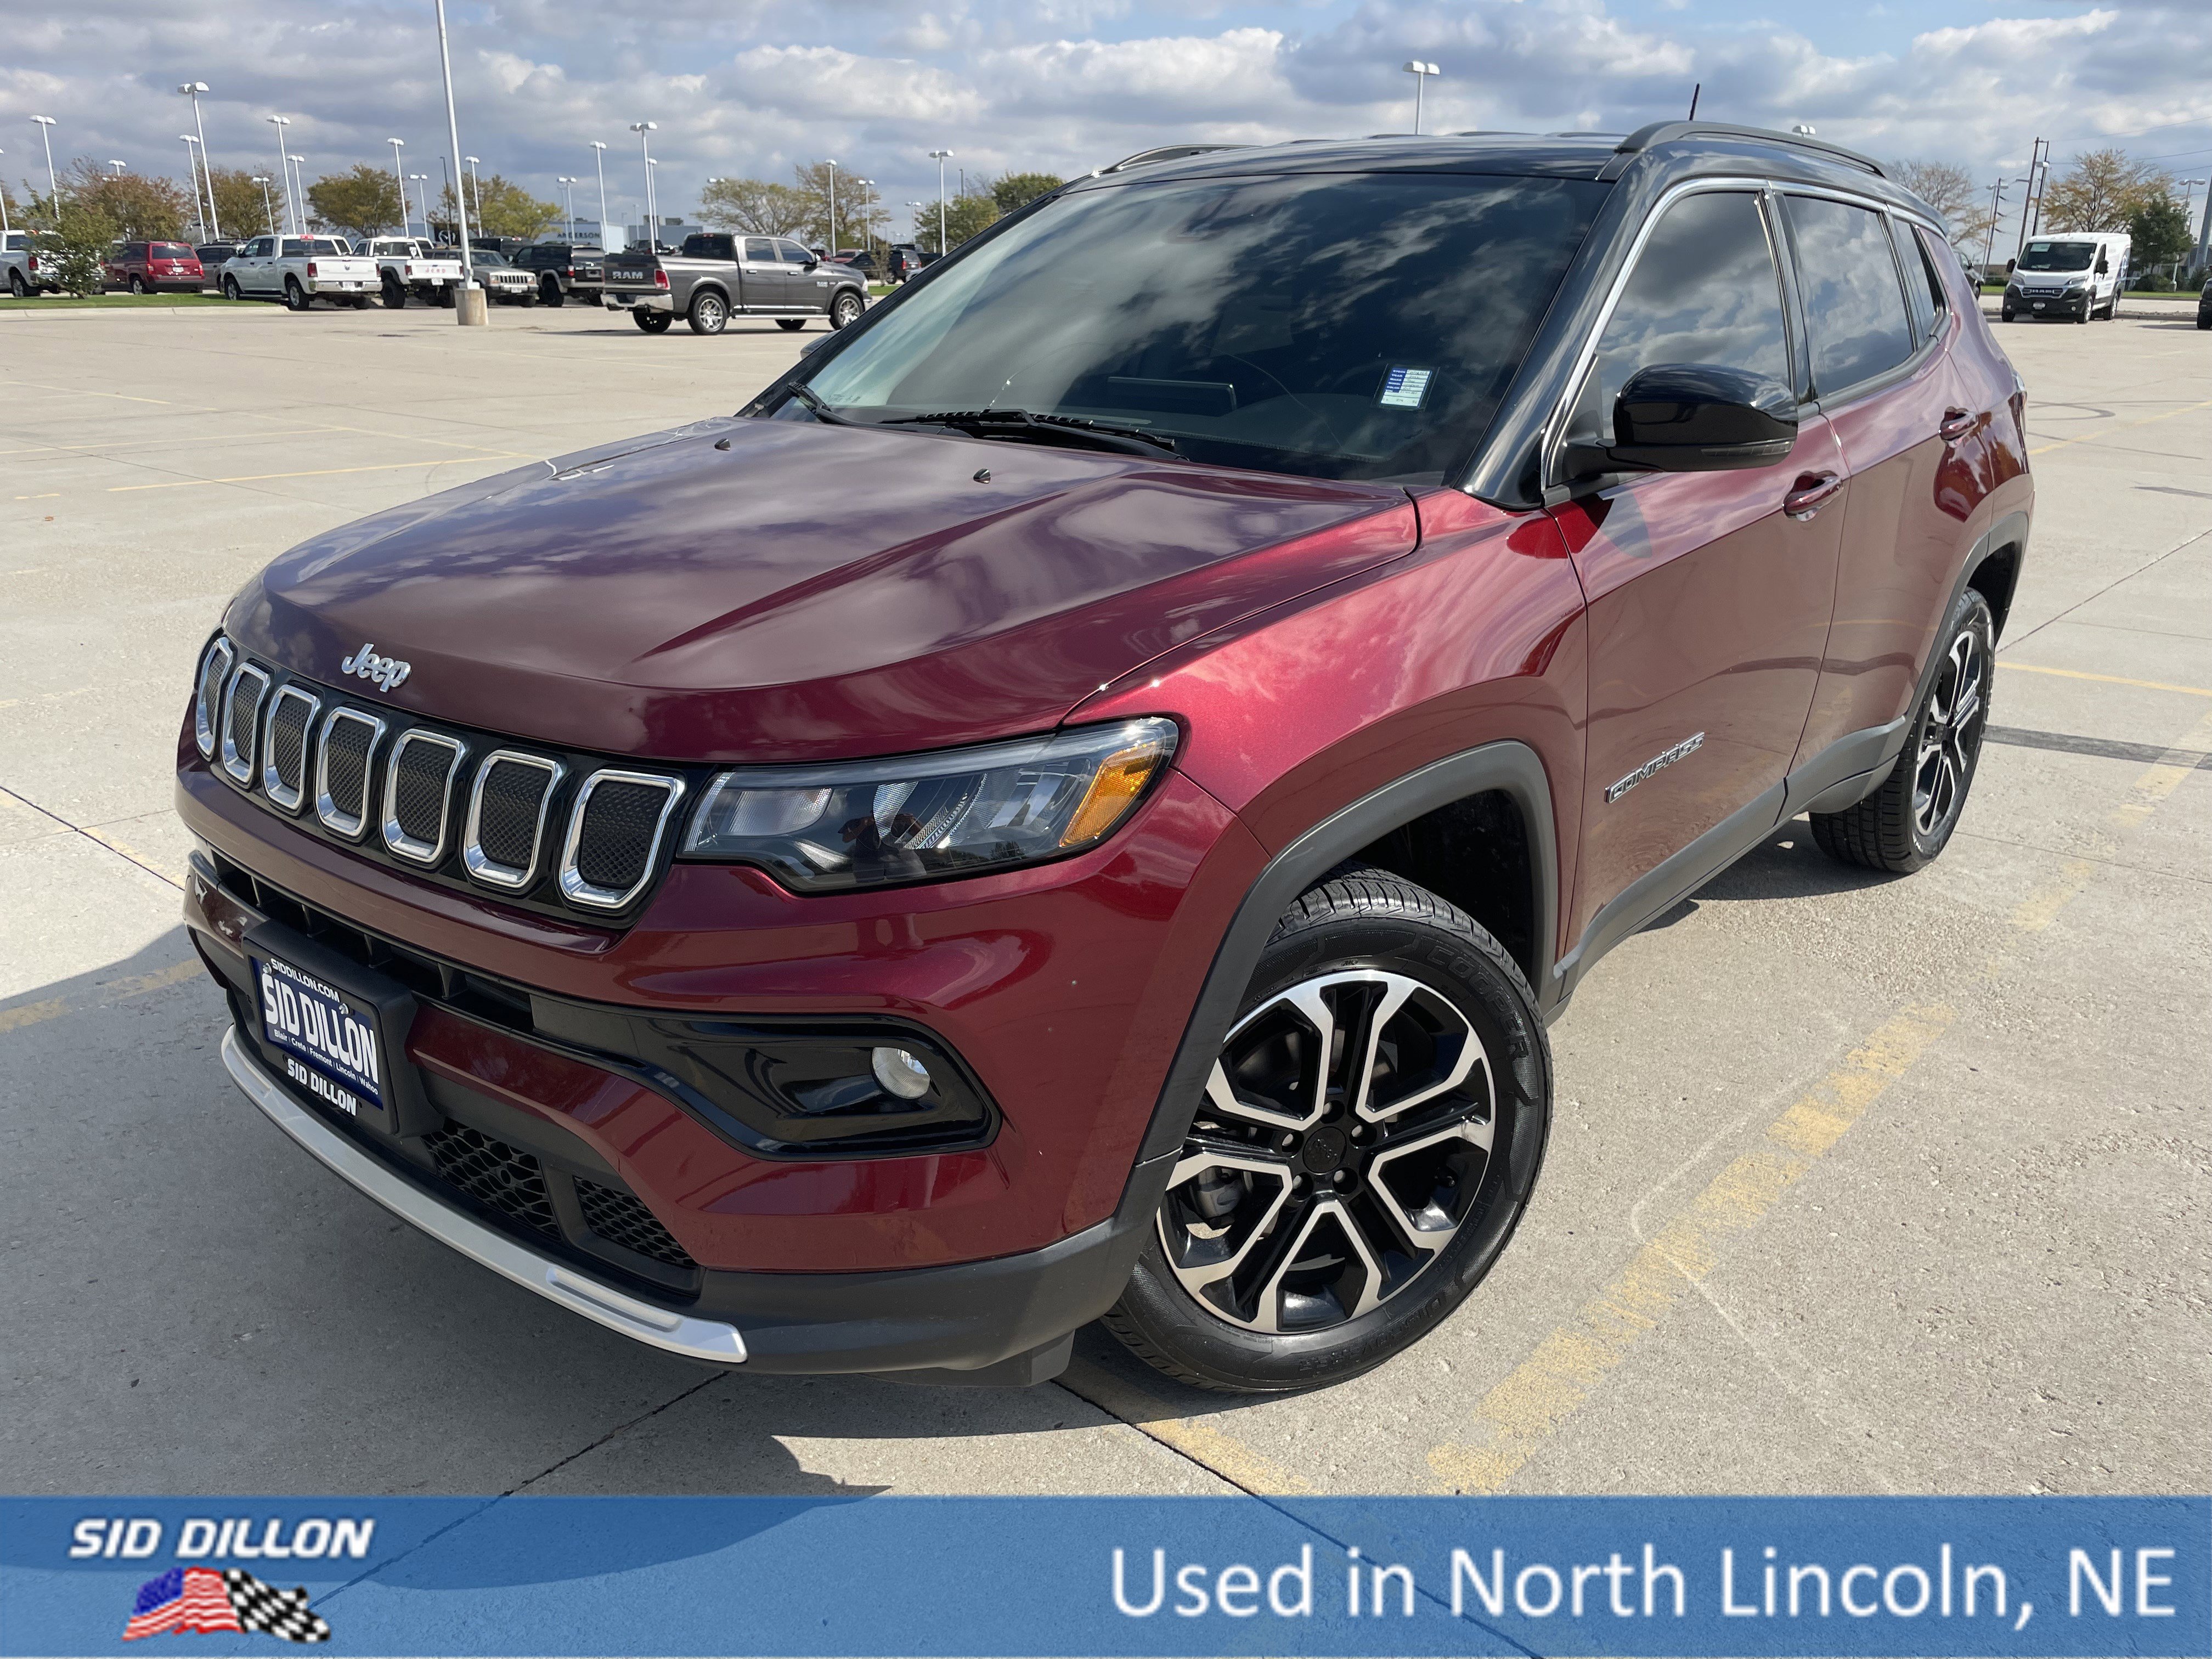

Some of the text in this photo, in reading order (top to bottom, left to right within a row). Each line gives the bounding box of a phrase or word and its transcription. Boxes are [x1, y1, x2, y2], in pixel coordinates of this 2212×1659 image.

[612, 271, 644, 279] RAM
[341, 643, 411, 693] Jeep
[1605, 731, 1705, 803] COMPASS
[270, 958, 340, 1003] SIDDILLON.COM
[1427, 945, 1530, 1060] COOPER
[262, 973, 379, 1084] SID DILLON
[274, 1029, 379, 1095] Blair Crete Fremont Lincoln Wahoo
[287, 1058, 357, 1116] SID DILLON
